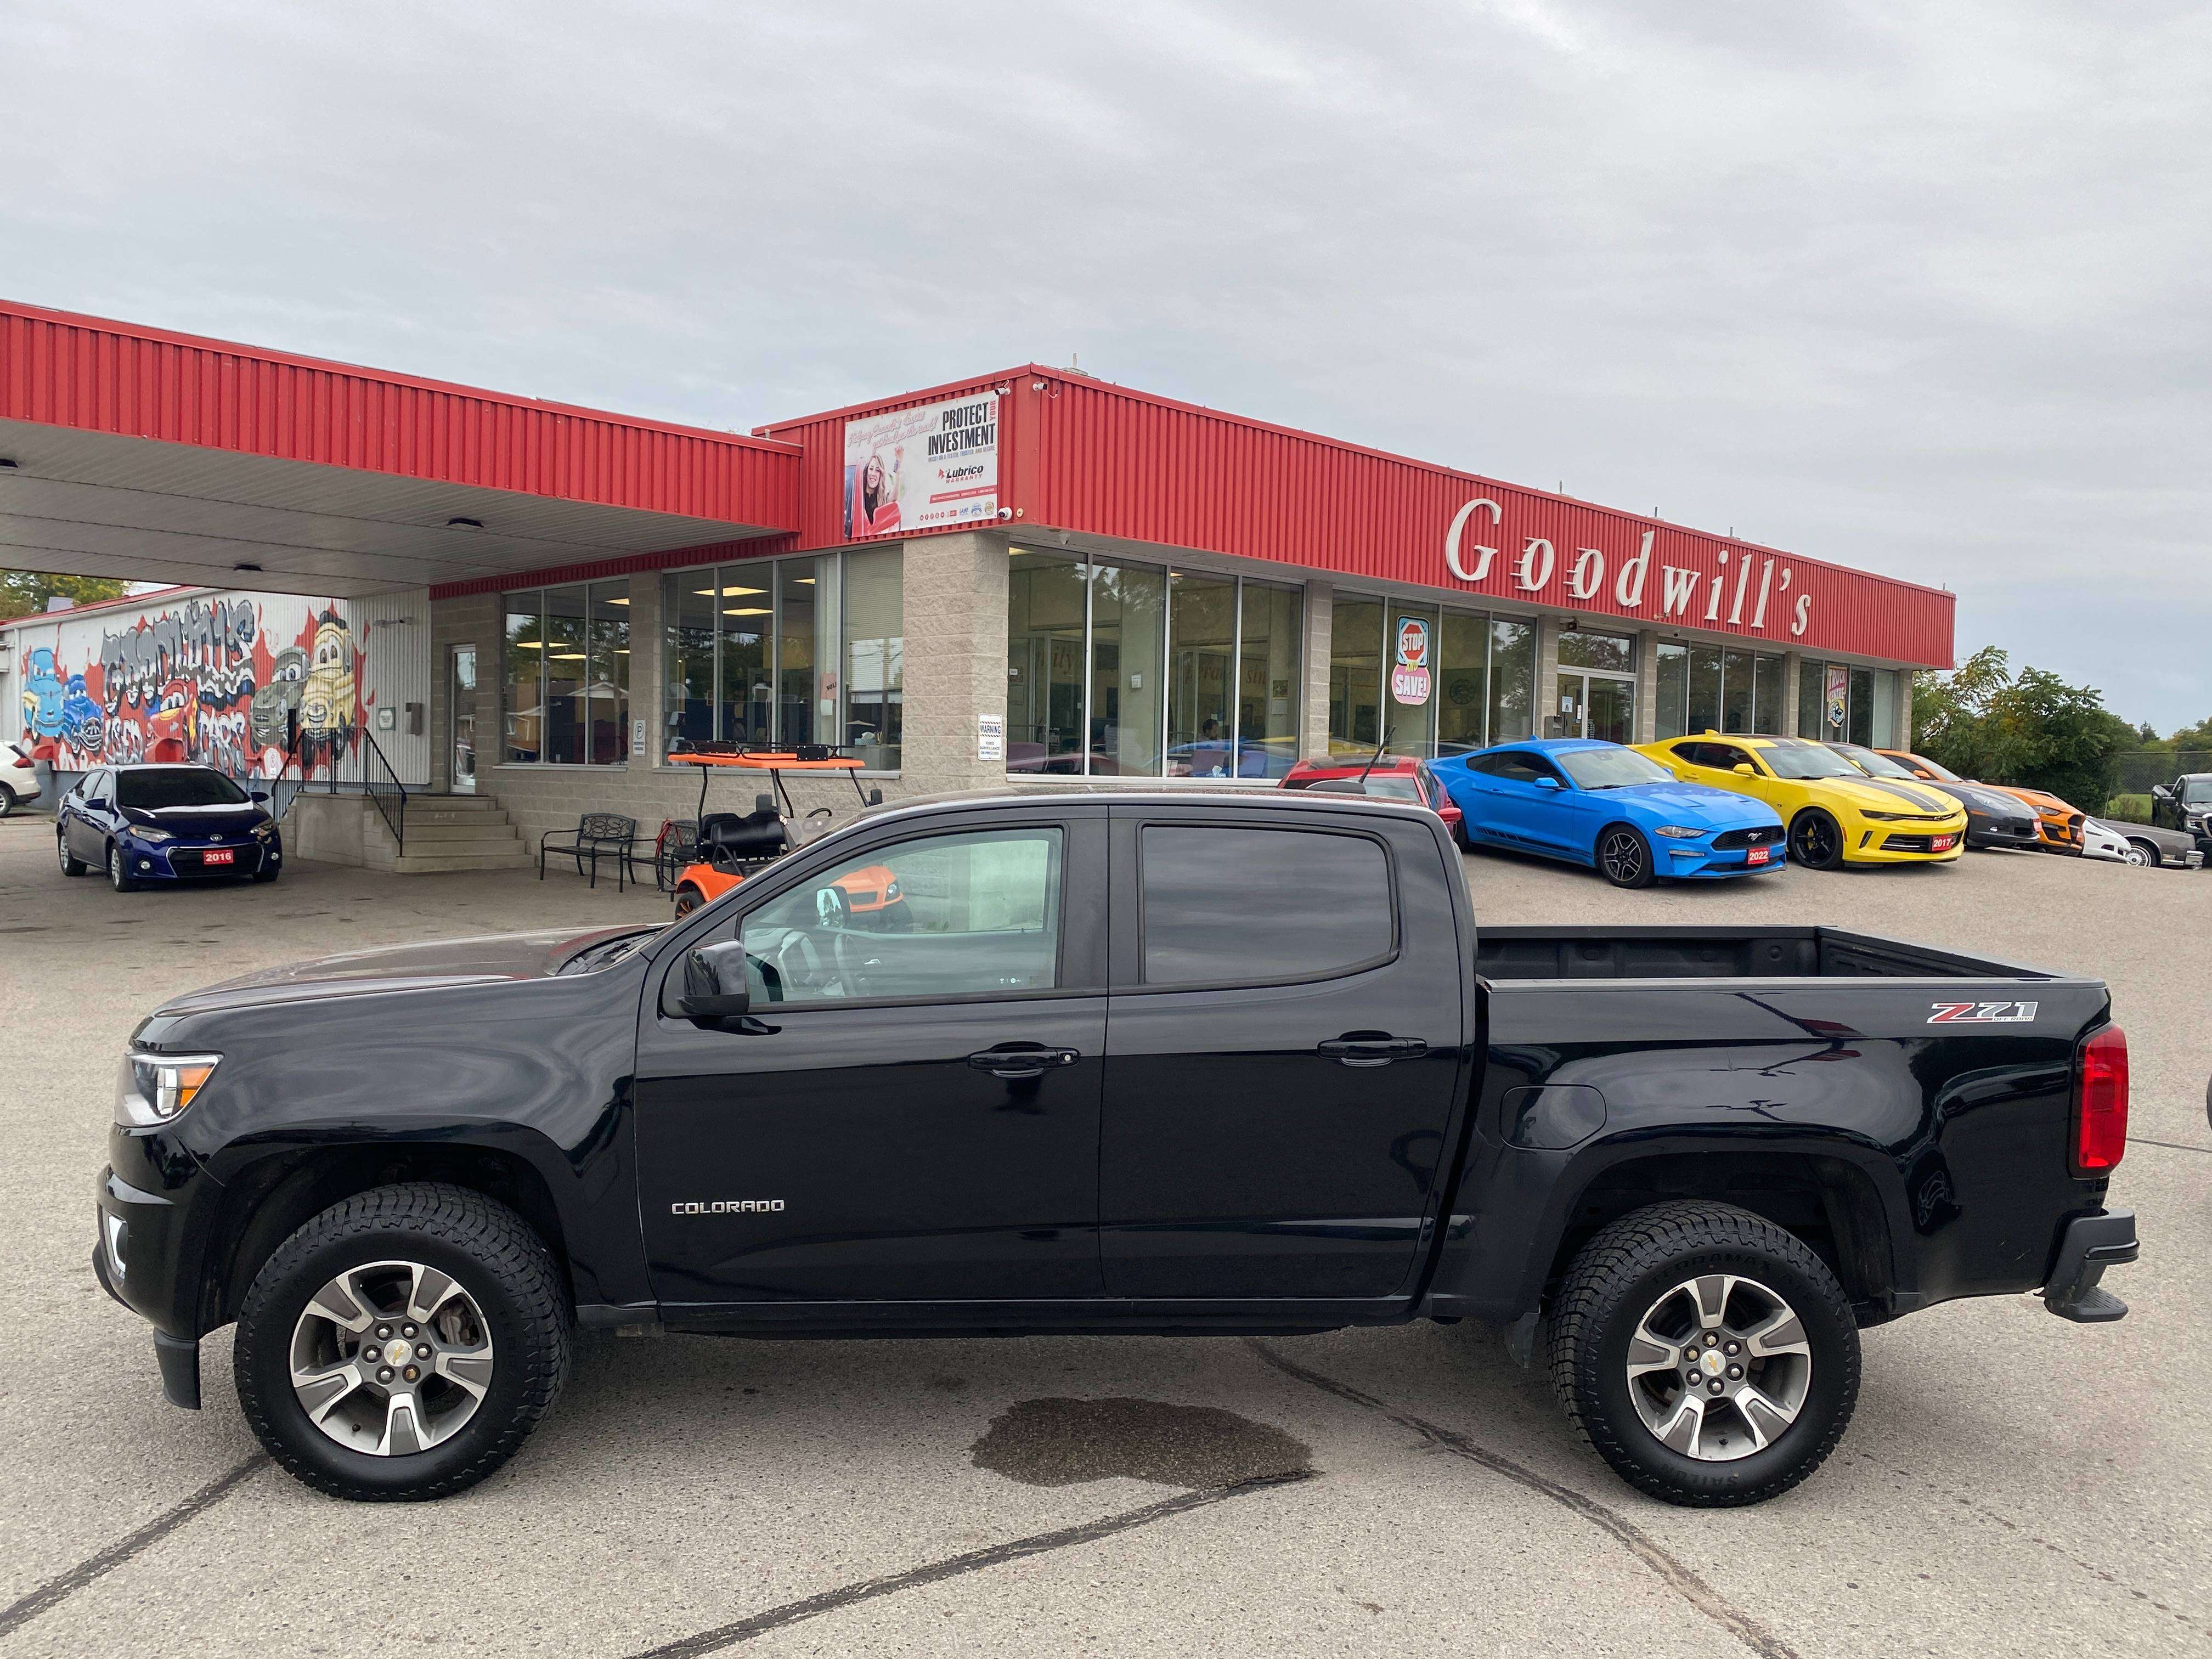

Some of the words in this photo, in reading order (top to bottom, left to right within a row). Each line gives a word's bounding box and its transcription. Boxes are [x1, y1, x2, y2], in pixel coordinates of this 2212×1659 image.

[943, 402, 989, 431] PROTECT
[928, 423, 996, 455] INVESTMENT
[945, 473, 983, 484] WARRANTY
[946, 465, 984, 479] Lubrico
[1446, 498, 1811, 636] Goodwill's
[1402, 633, 1424, 652] STOP
[1406, 662, 1418, 673] AND
[826, 681, 837, 691] SOL
[1396, 674, 1427, 698] SAVE!
[1829, 669, 1846, 690] TRUCK
[980, 725, 1001, 734] WARNING
[1933, 838, 1951, 848] 2017
[206, 853, 232, 862] 2016
[1749, 850, 1768, 861] 2022
[1926, 1001, 2039, 1024] Z71
[672, 1200, 785, 1215] COLORADO
